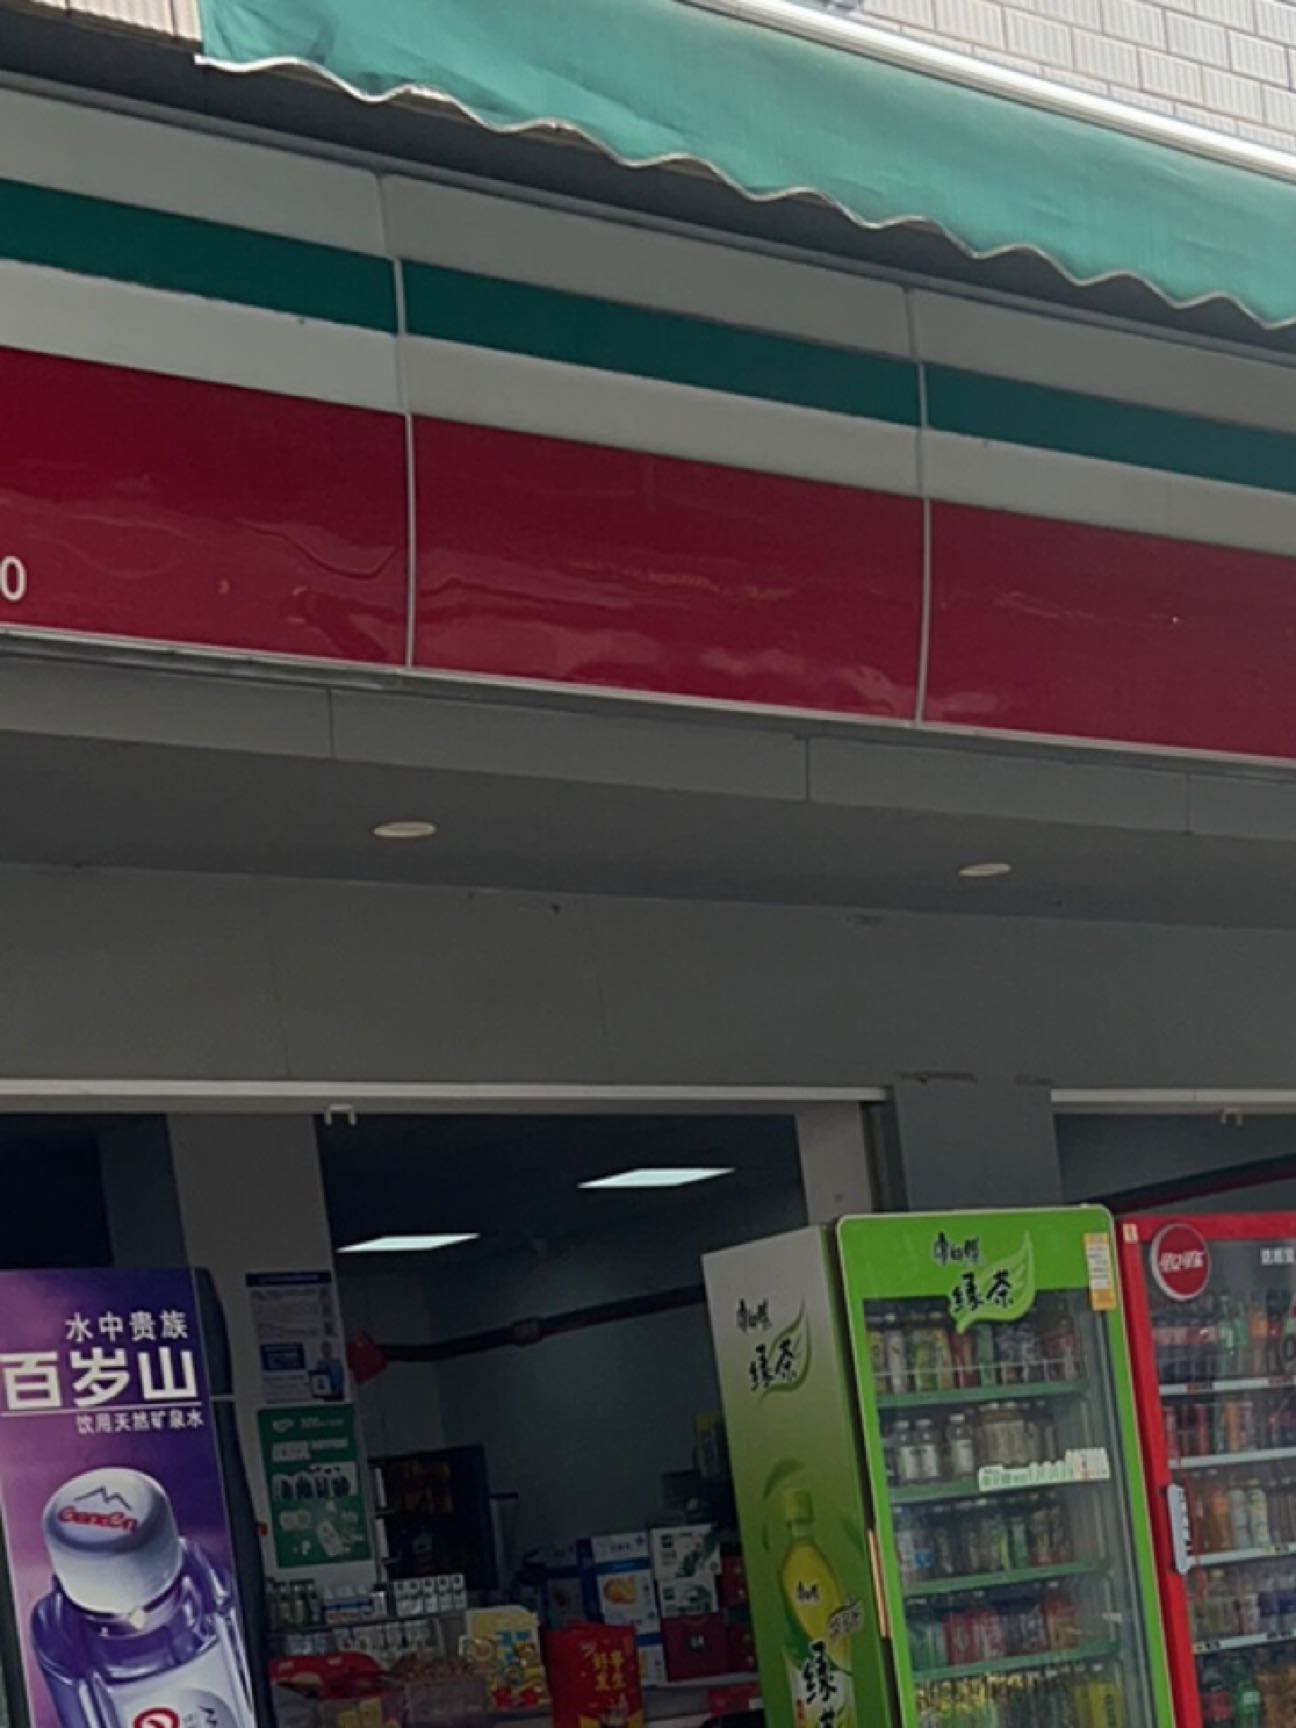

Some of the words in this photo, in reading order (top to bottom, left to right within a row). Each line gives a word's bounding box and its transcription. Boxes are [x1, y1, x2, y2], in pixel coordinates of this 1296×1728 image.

[65, 1310, 189, 1342] 水中贵族
[0, 1346, 198, 1411] 百岁山
[76, 1408, 205, 1435] 饮用天然矿泉水
